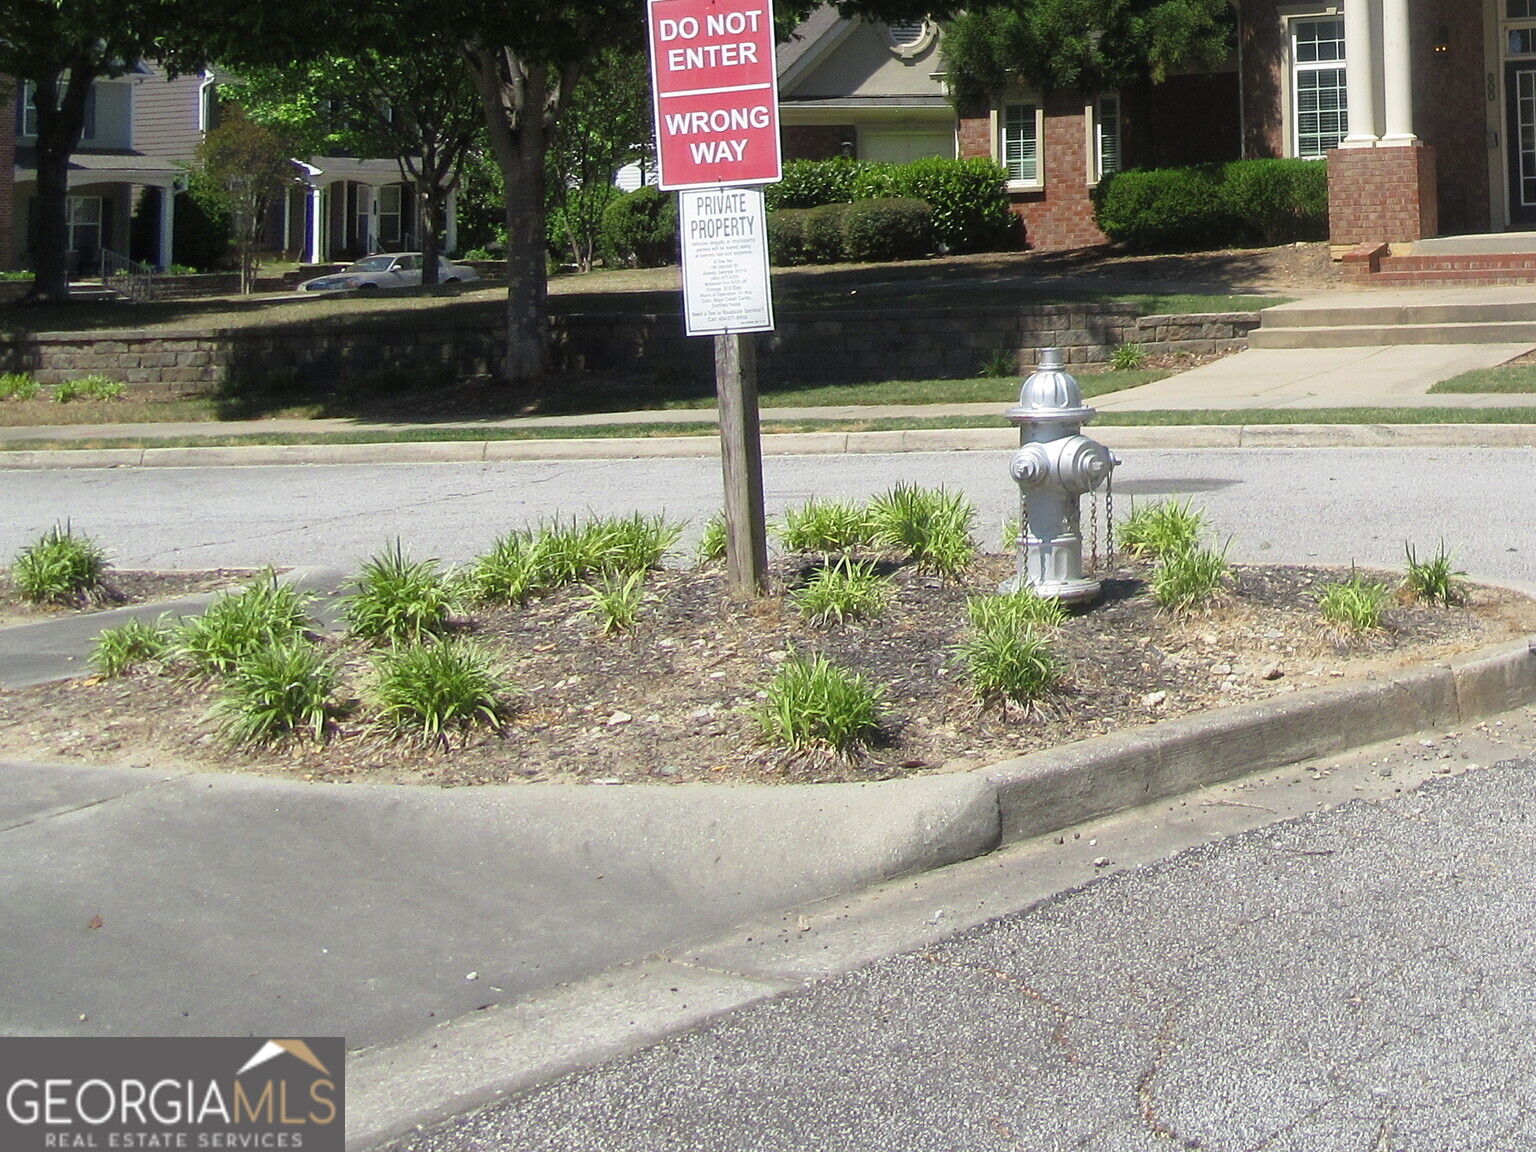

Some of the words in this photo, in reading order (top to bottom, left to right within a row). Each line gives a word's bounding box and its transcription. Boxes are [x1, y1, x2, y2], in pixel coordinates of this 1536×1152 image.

[659, 16, 699, 41] DO
[706, 10, 762, 37] NOT
[668, 42, 758, 71] ENTER
[665, 106, 770, 136] WRONG
[690, 139, 749, 164] WAY
[697, 193, 746, 216] PRIVATE
[691, 216, 754, 239] PROPERTY
